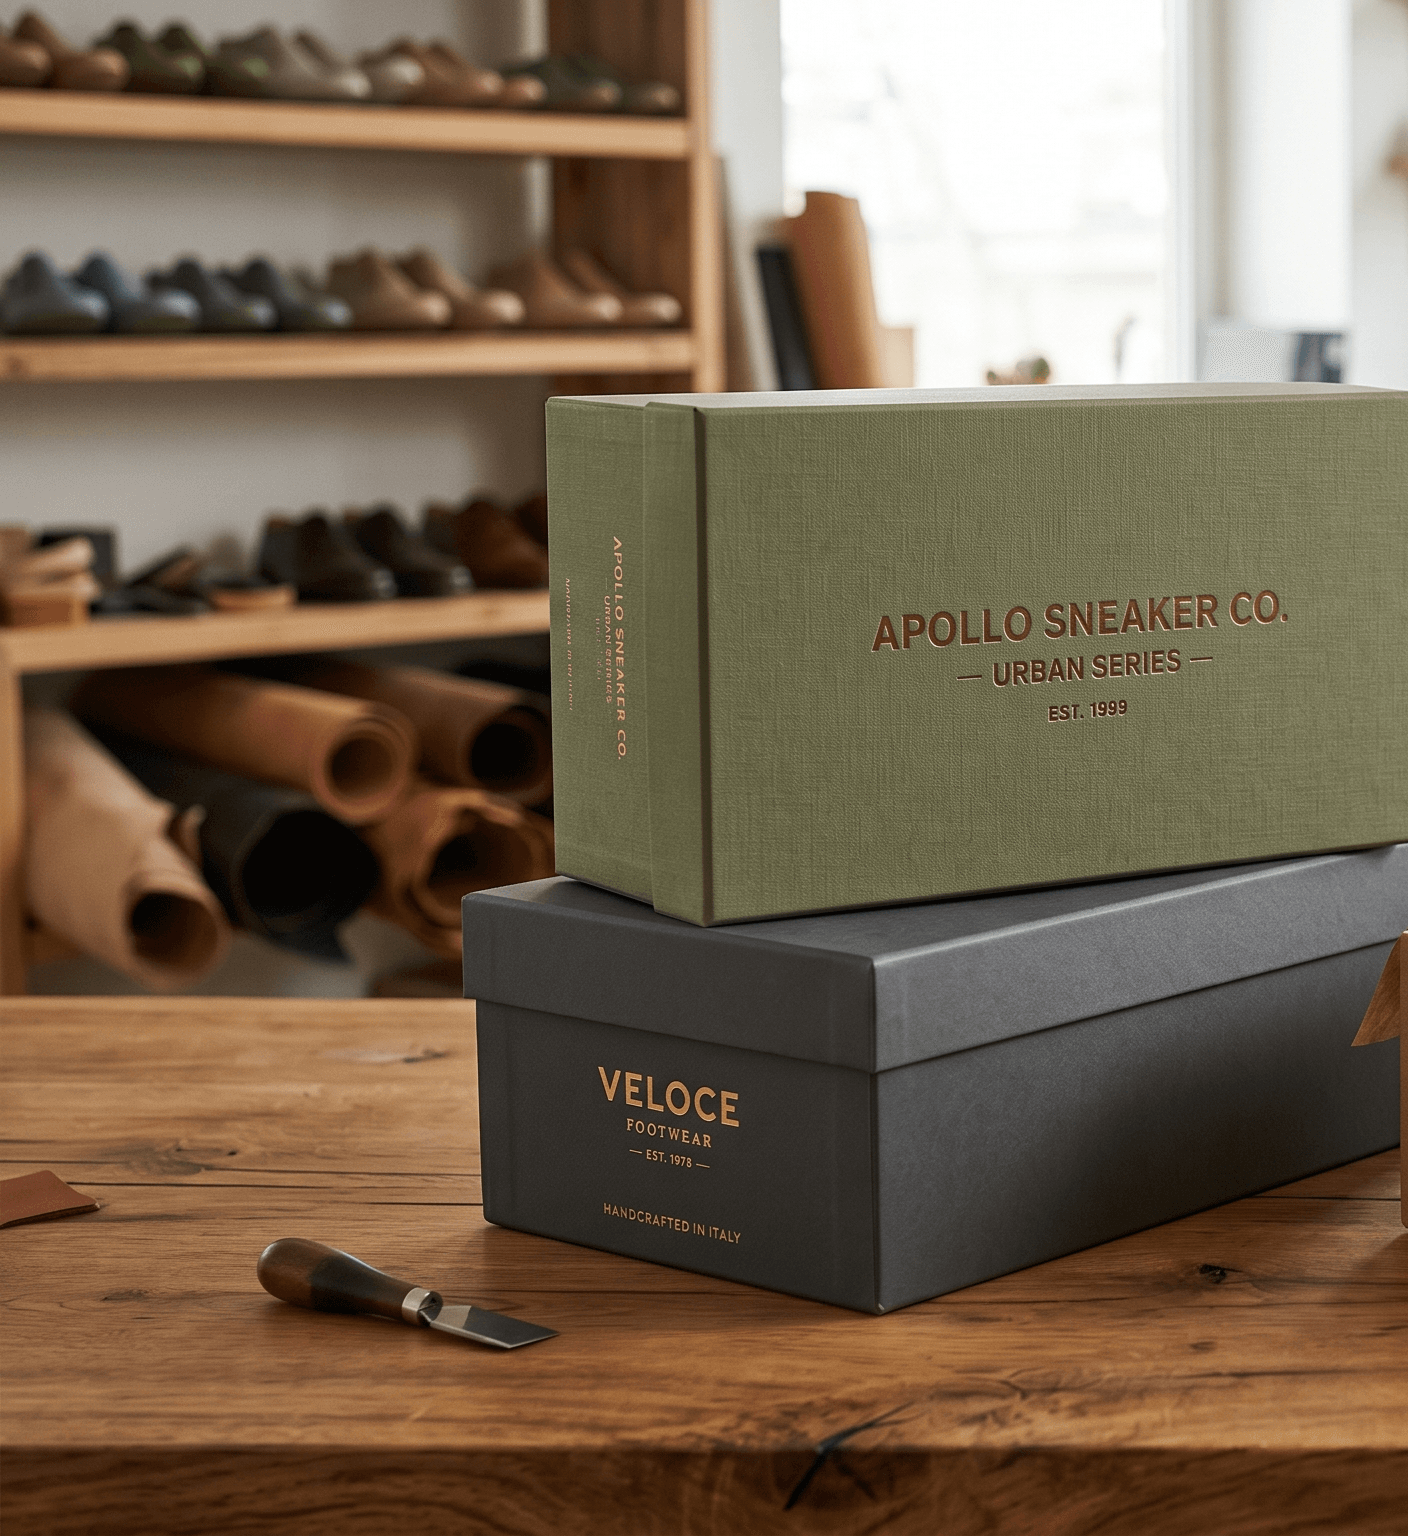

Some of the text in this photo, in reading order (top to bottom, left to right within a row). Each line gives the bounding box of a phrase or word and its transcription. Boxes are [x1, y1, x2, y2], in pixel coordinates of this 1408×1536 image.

[871, 590, 1288, 652] APOLLO SNEAKER CO.
[613, 536, 627, 760] APOLLO SNEAKER CO.
[993, 649, 1181, 687] URBAN SERIES
[1048, 700, 1128, 722] EST. 1999
[598, 1066, 740, 1128] VELOCE
[626, 1117, 712, 1148] FOOTWEAR
[646, 1149, 693, 1168] EST. 1978
[603, 1202, 741, 1244] HANDCRAFTED IN ITALY
